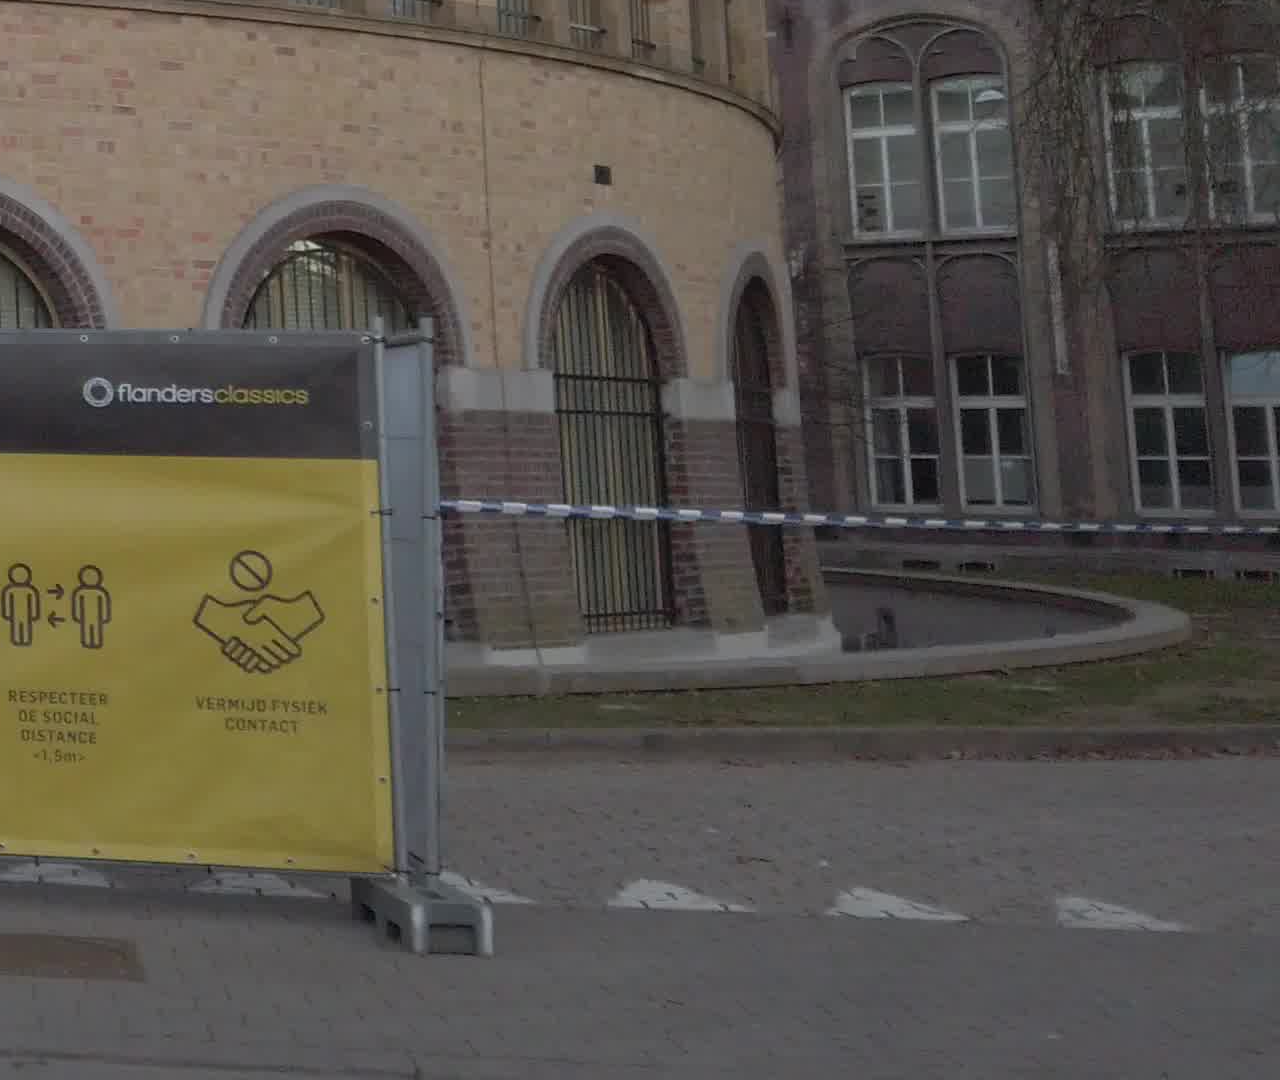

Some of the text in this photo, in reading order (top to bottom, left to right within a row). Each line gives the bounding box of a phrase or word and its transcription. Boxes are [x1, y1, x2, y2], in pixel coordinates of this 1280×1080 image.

[7, 689, 109, 706] RESPECTEER
[194, 695, 328, 716] VERMIJD FYSIEK
[17, 709, 100, 727] DE SOCIAL
[224, 717, 300, 735] CONTACT
[20, 728, 97, 746] DISTANCE
